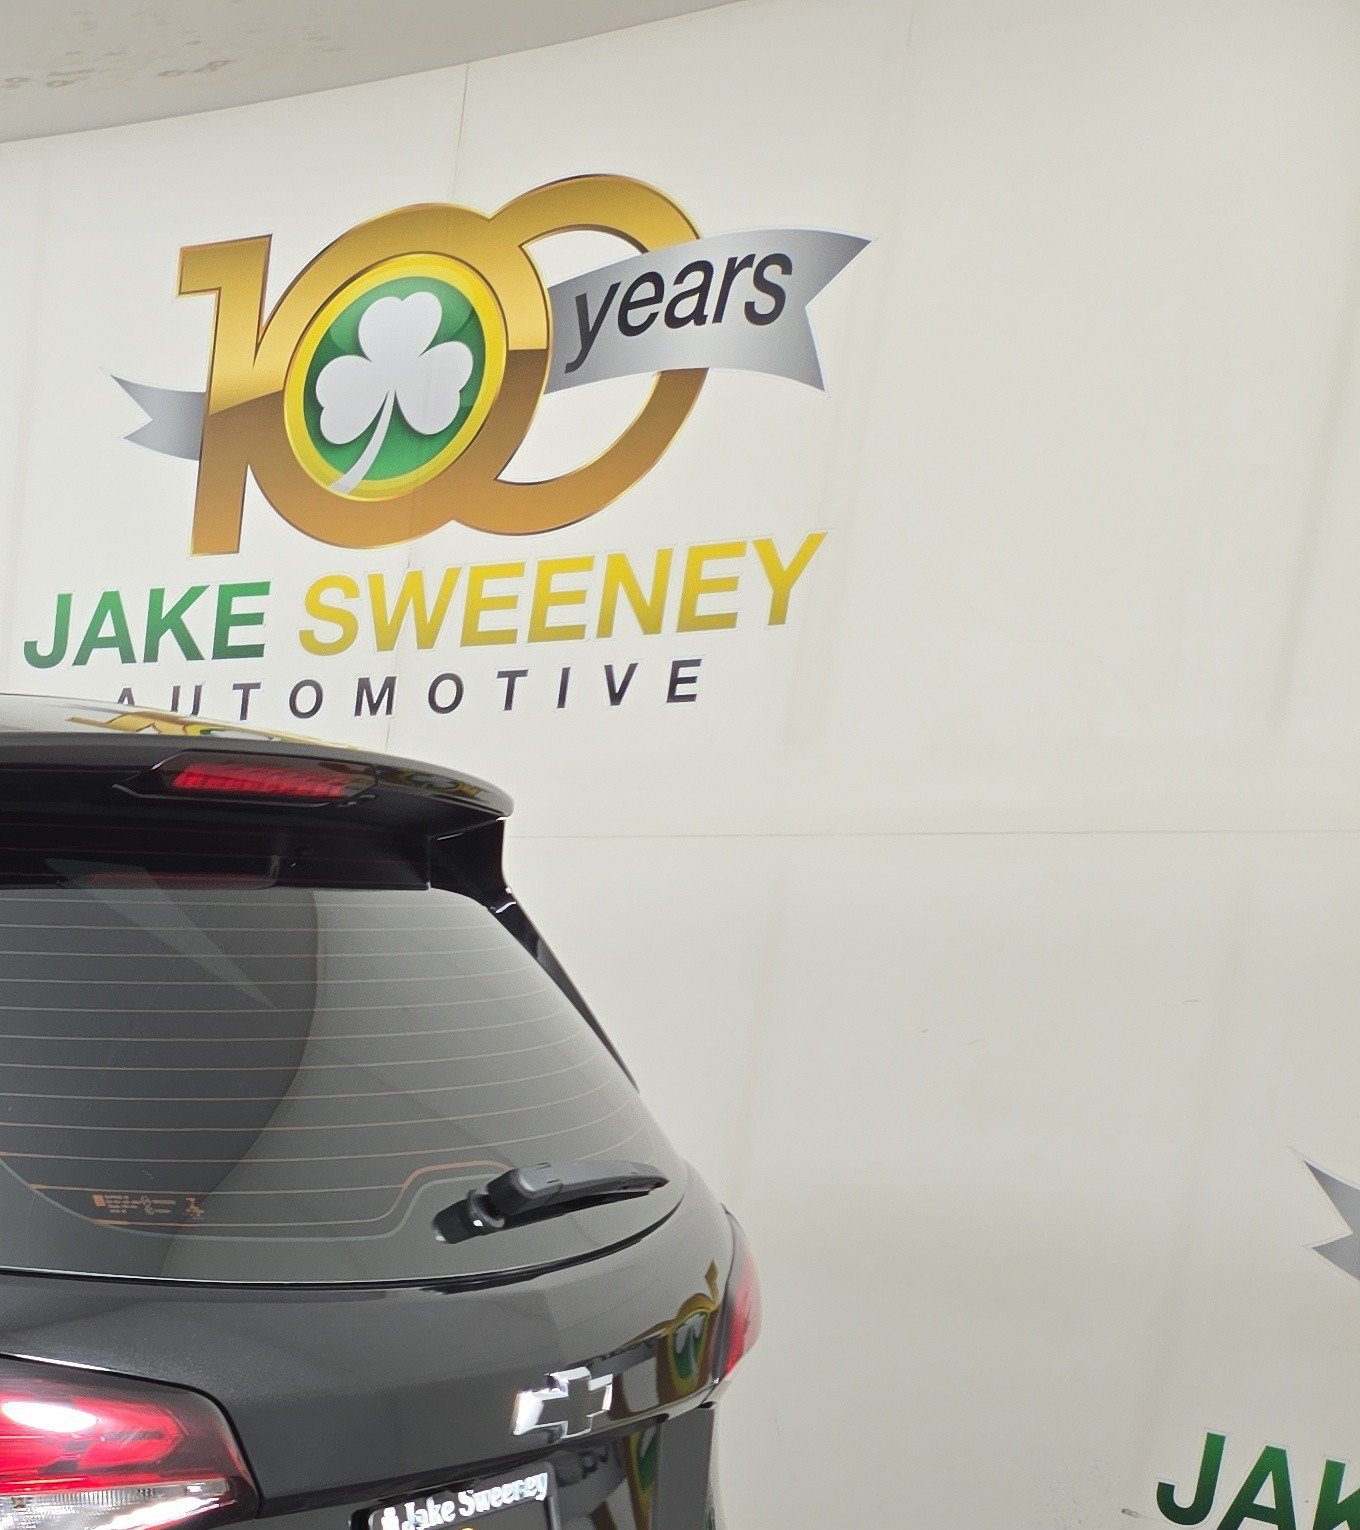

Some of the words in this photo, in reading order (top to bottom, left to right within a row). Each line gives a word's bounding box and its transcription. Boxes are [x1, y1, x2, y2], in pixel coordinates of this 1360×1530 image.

[178, 174, 711, 555] 100
[566, 252, 794, 373] years
[24, 580, 271, 669] JAKE
[299, 532, 827, 655] SWEENEY
[457, 1472, 548, 1517] Sweeney
